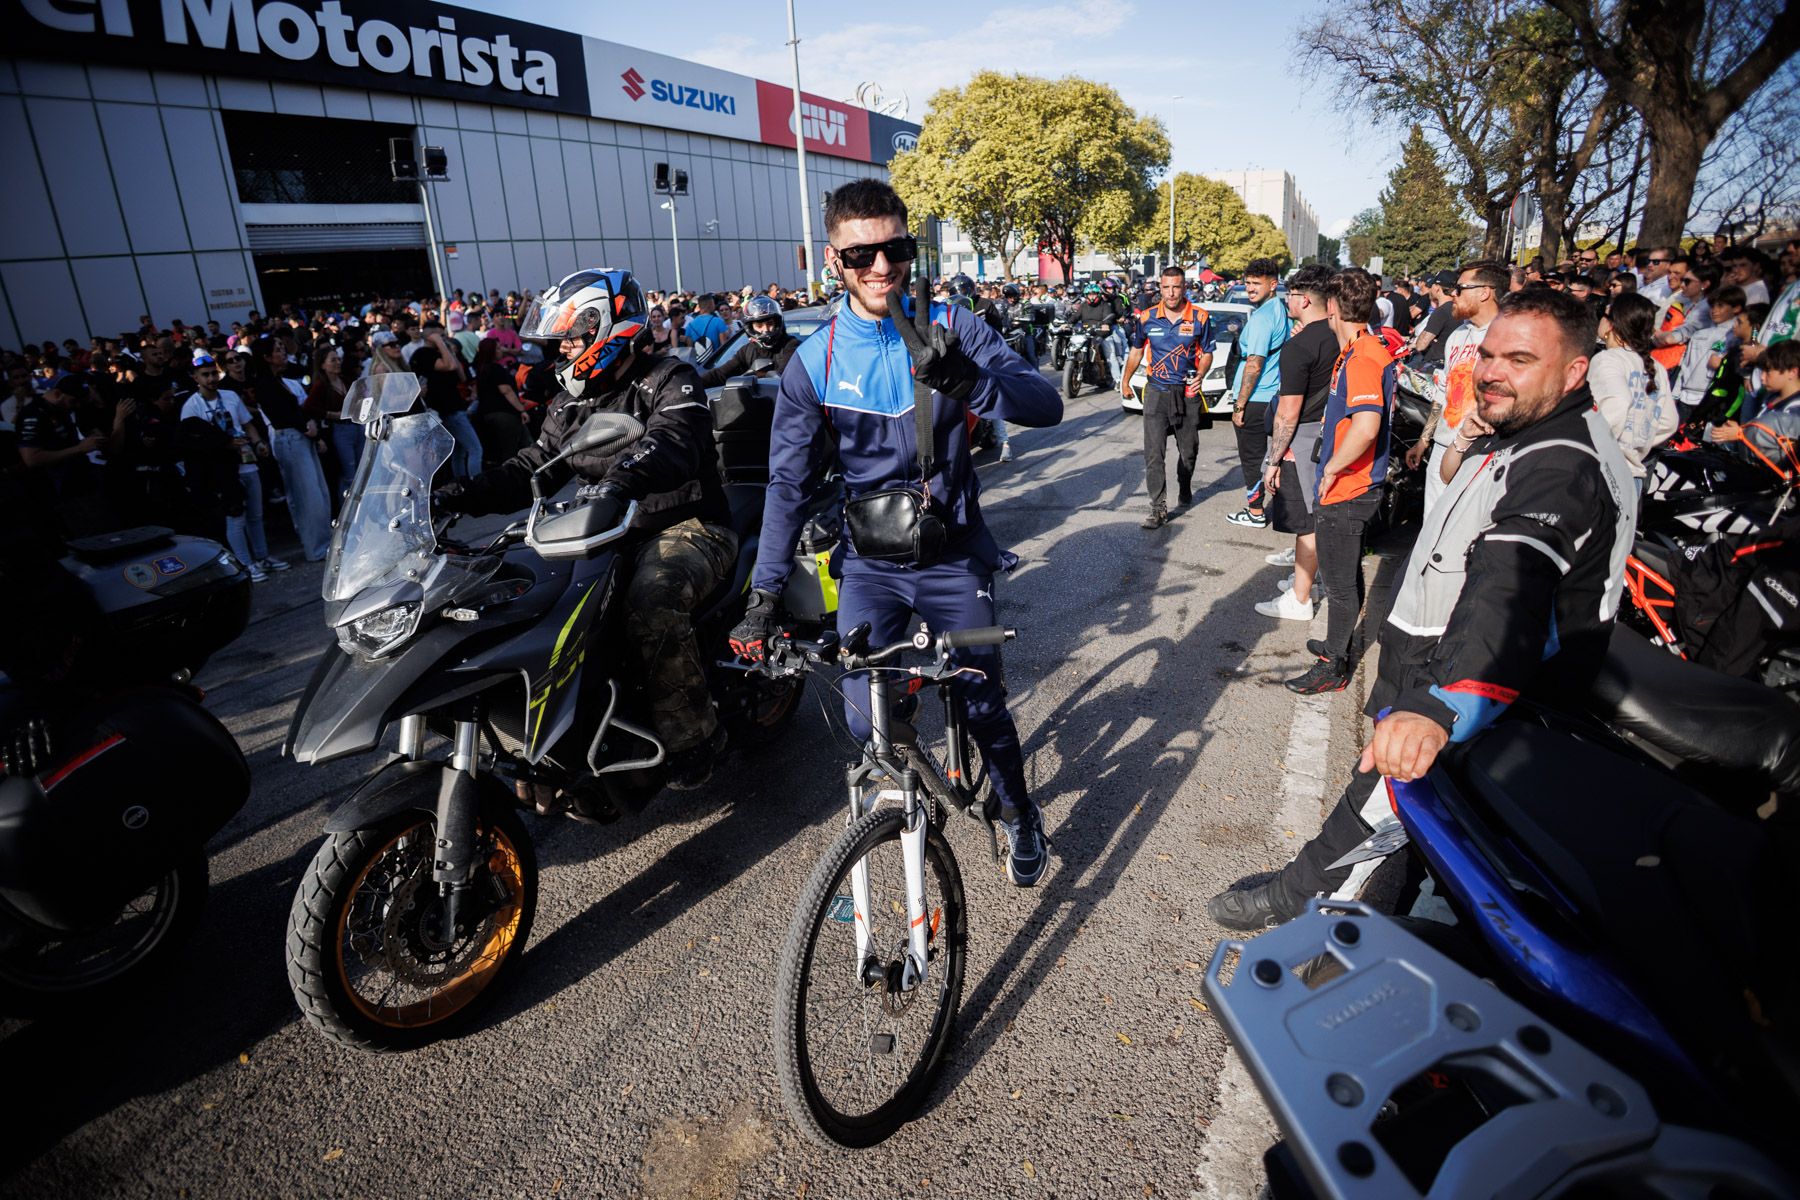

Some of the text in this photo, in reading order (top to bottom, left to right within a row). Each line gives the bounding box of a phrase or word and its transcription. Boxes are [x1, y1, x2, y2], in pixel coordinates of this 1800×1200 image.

[160, 0, 560, 97] Motorista
[651, 79, 736, 116] SUZUKI
[788, 101, 846, 147] GIVI
[915, 734, 953, 791] ROCKRIDER
